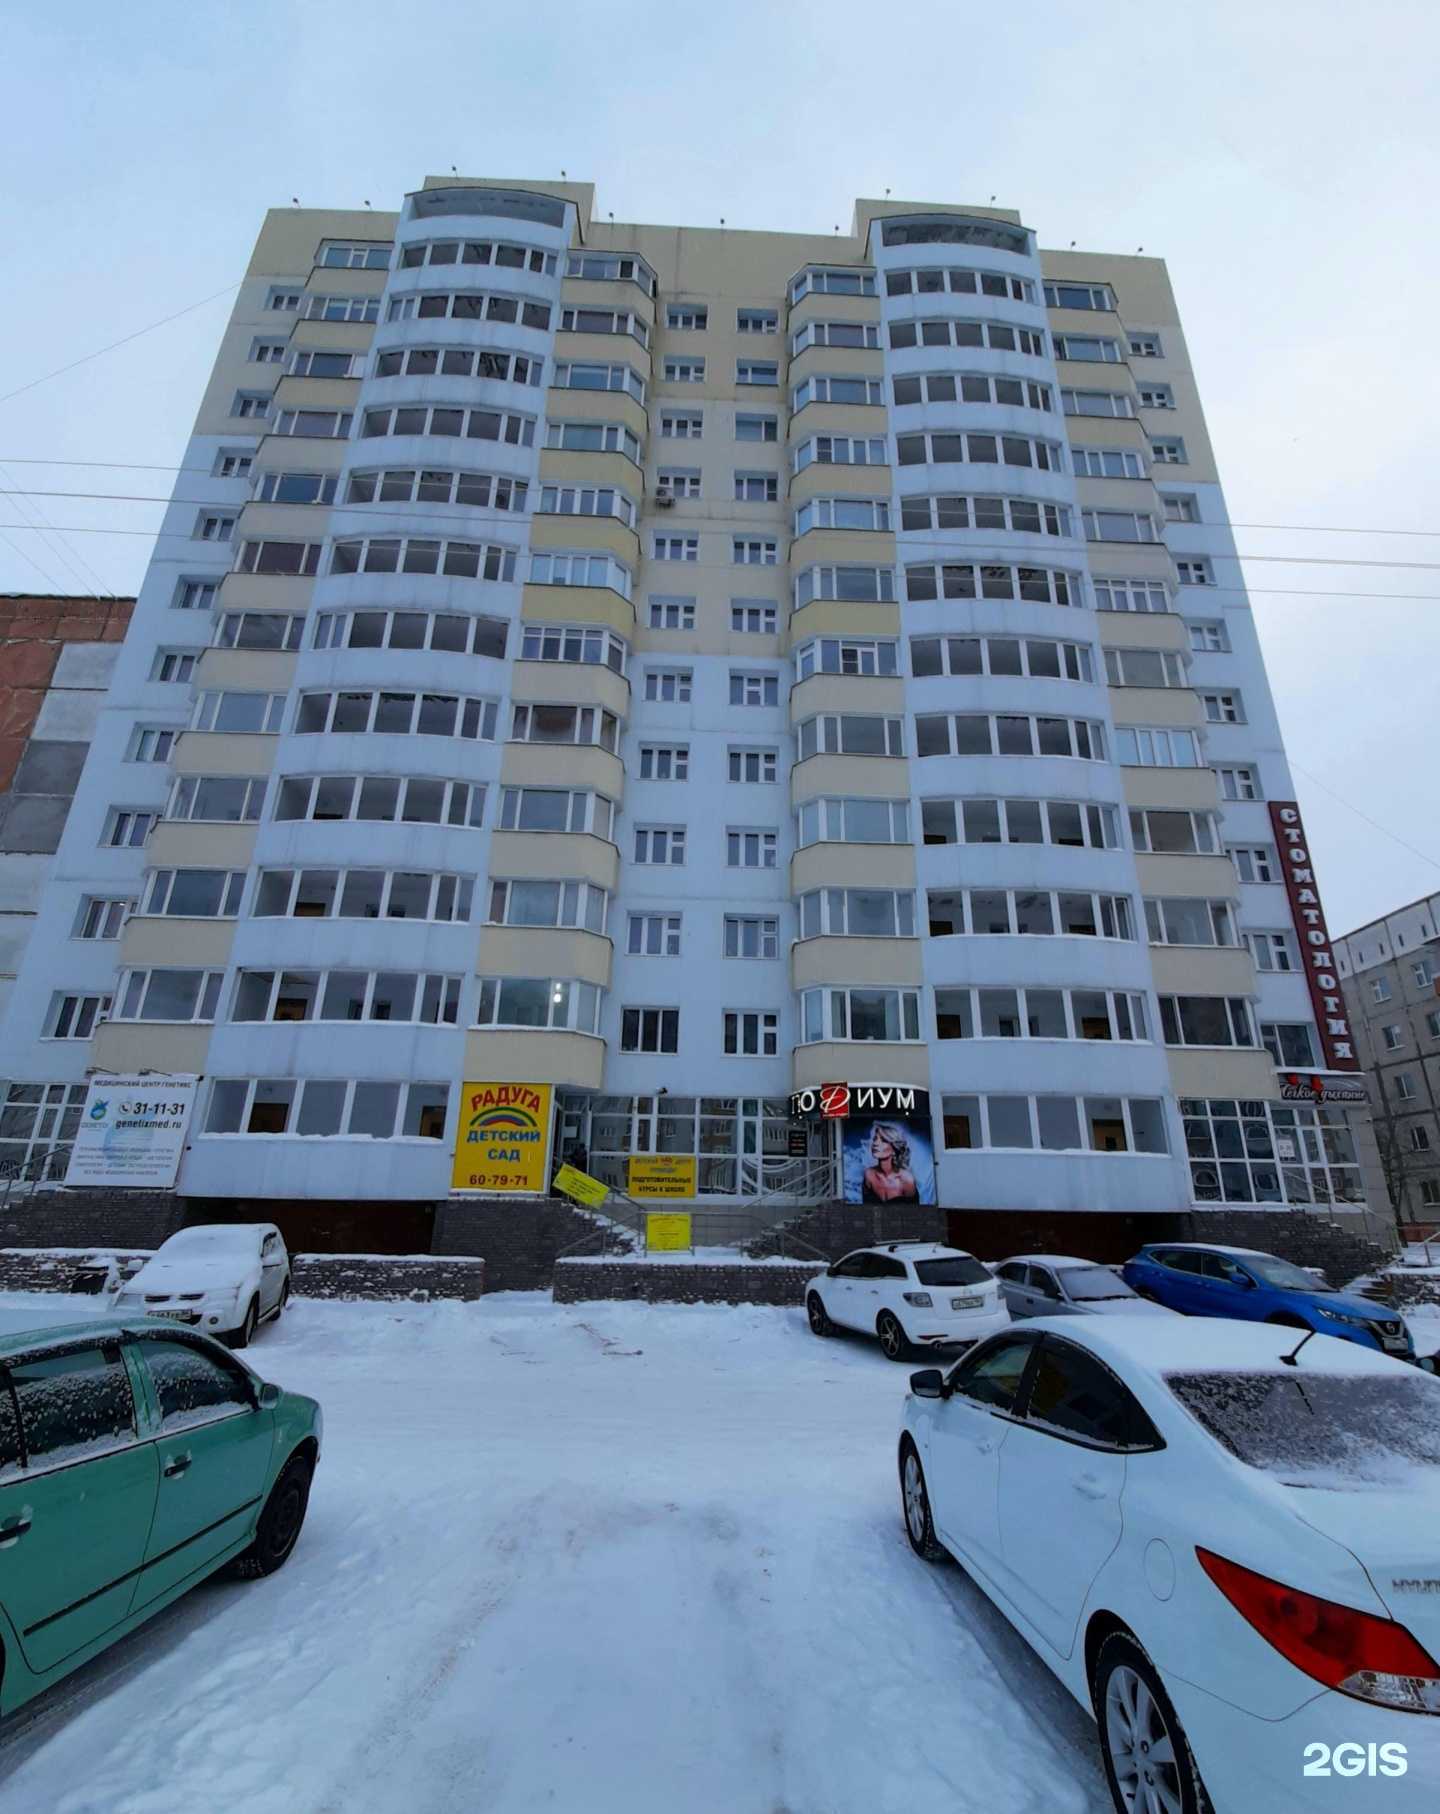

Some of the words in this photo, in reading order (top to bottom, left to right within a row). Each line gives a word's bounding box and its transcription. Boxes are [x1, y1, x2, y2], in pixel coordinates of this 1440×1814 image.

[1279, 808, 1353, 1059] СТОМАТОЛОГИЯ
[471, 1086, 541, 1113] РАДУГА
[133, 1102, 185, 1117] 31-11-31
[467, 1129, 541, 1143] ДЕТСКИЙ
[487, 1148, 521, 1162] САД
